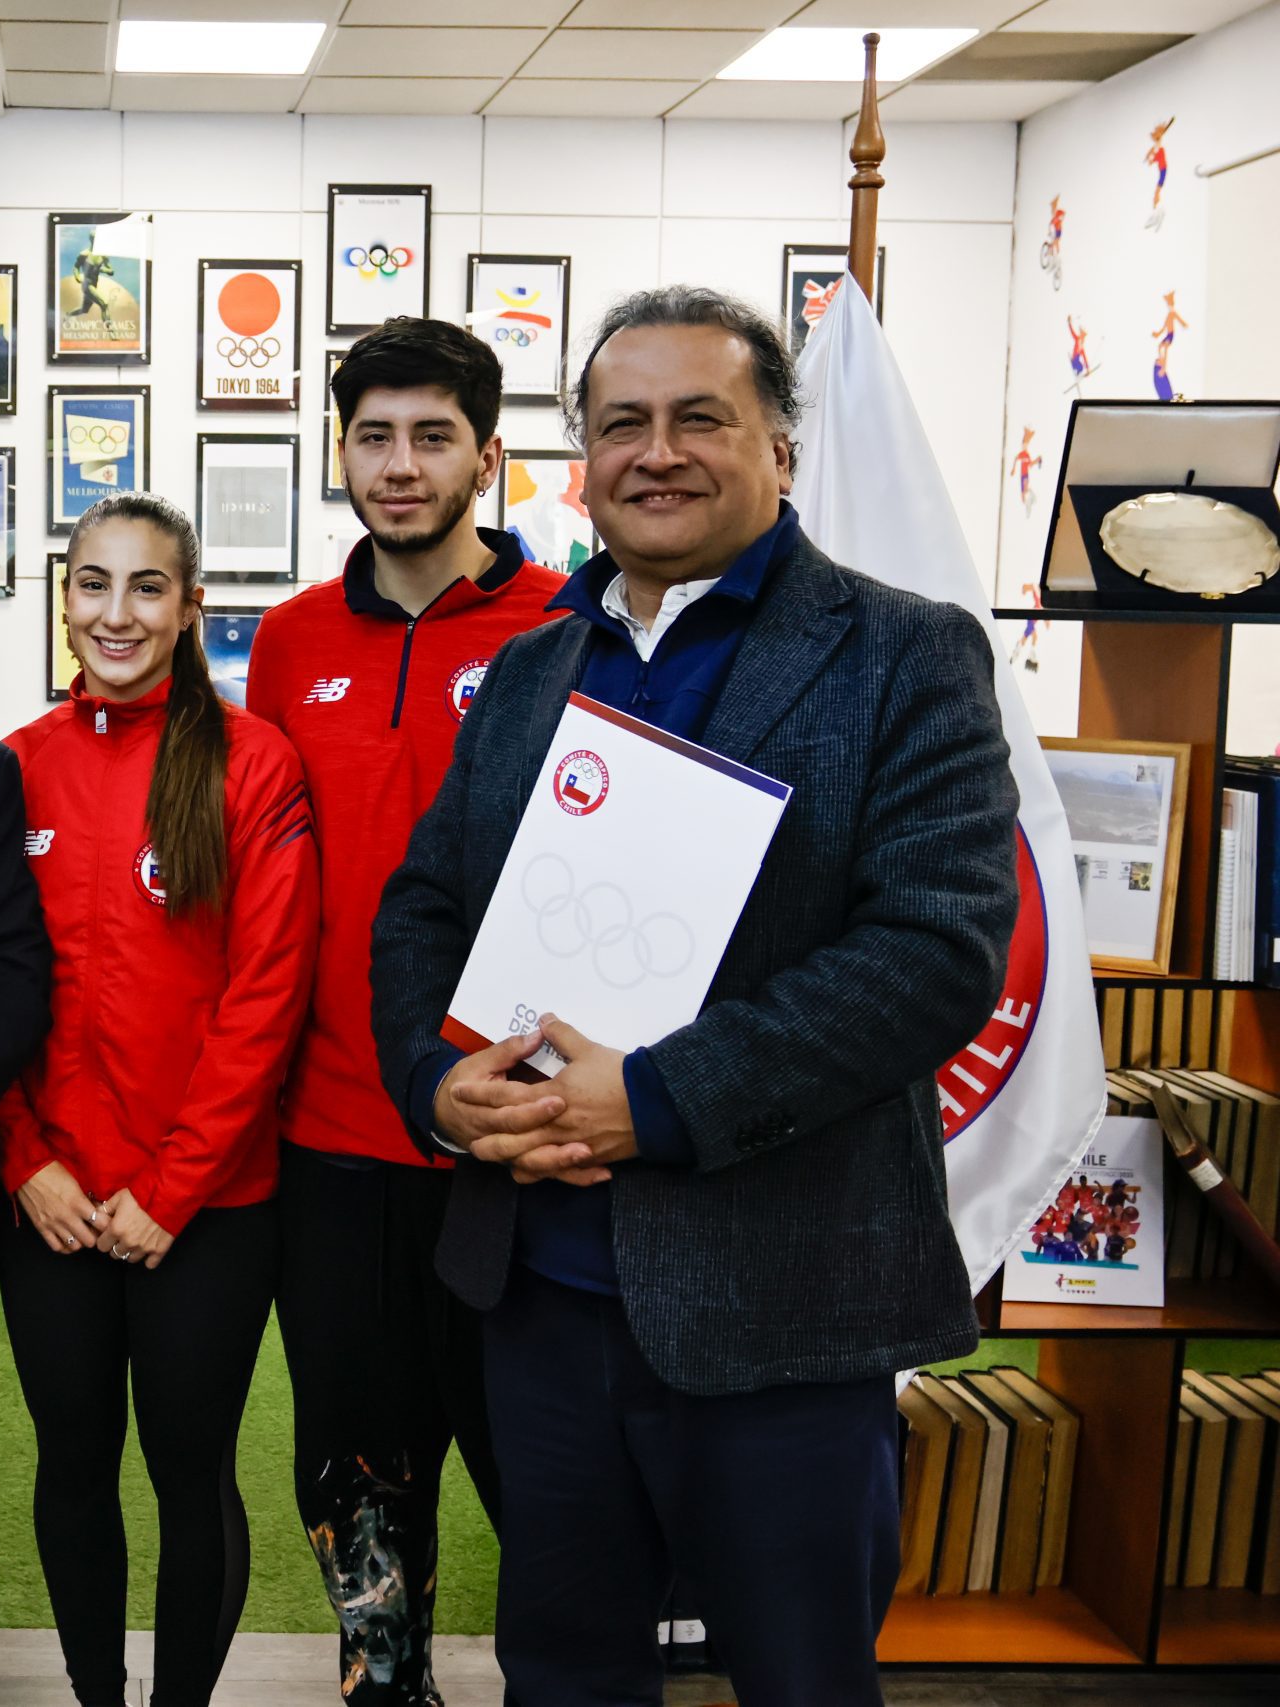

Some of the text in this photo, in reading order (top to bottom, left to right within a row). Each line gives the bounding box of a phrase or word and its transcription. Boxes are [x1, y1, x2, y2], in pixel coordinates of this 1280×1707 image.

[216, 377, 281, 395] TOKYO 1964
[559, 800, 583, 815] CHILE
[136, 843, 153, 864] COMI
[936, 997, 1032, 1131] HILE
[1081, 1154, 1107, 1167] HILE
